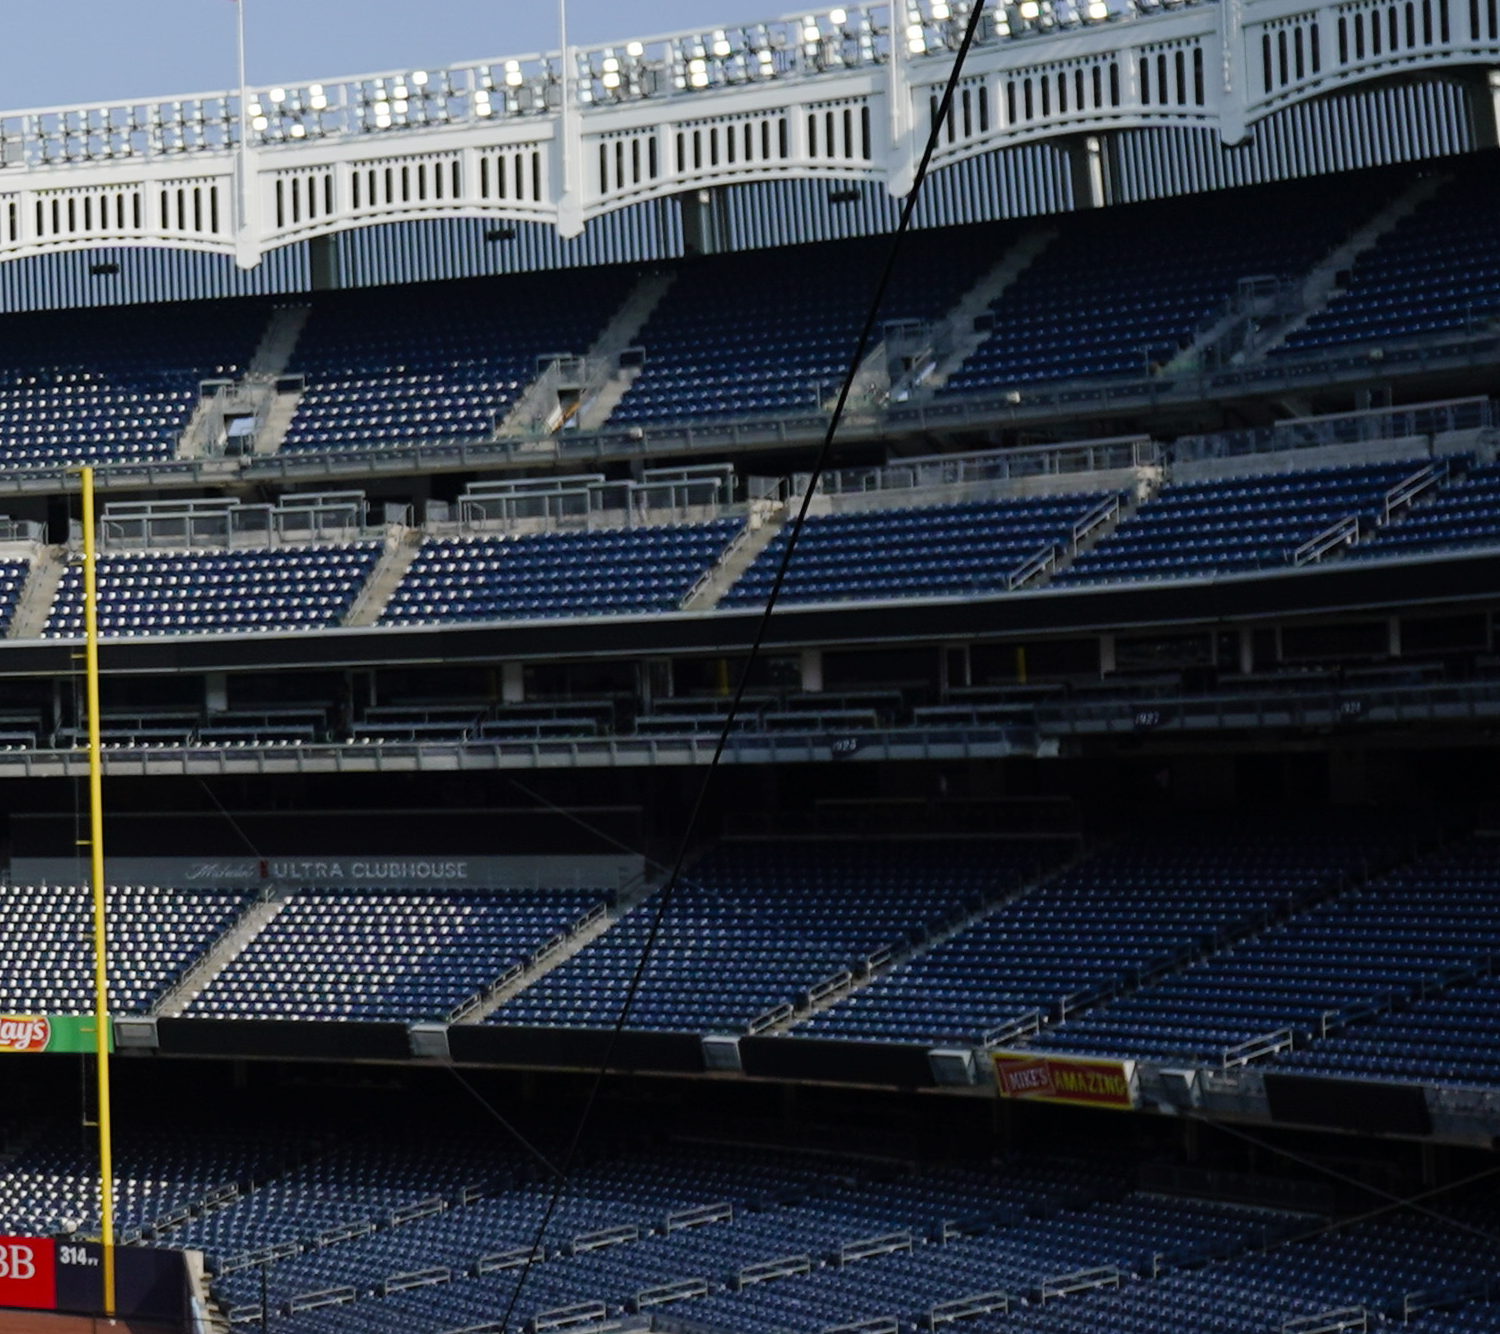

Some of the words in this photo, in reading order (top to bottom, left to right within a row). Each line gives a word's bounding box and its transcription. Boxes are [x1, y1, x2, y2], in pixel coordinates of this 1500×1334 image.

[274, 862, 344, 878] ULTRA
[351, 862, 467, 879] CLUBHOUSE
[1054, 1070, 1128, 1096] AMAZING
